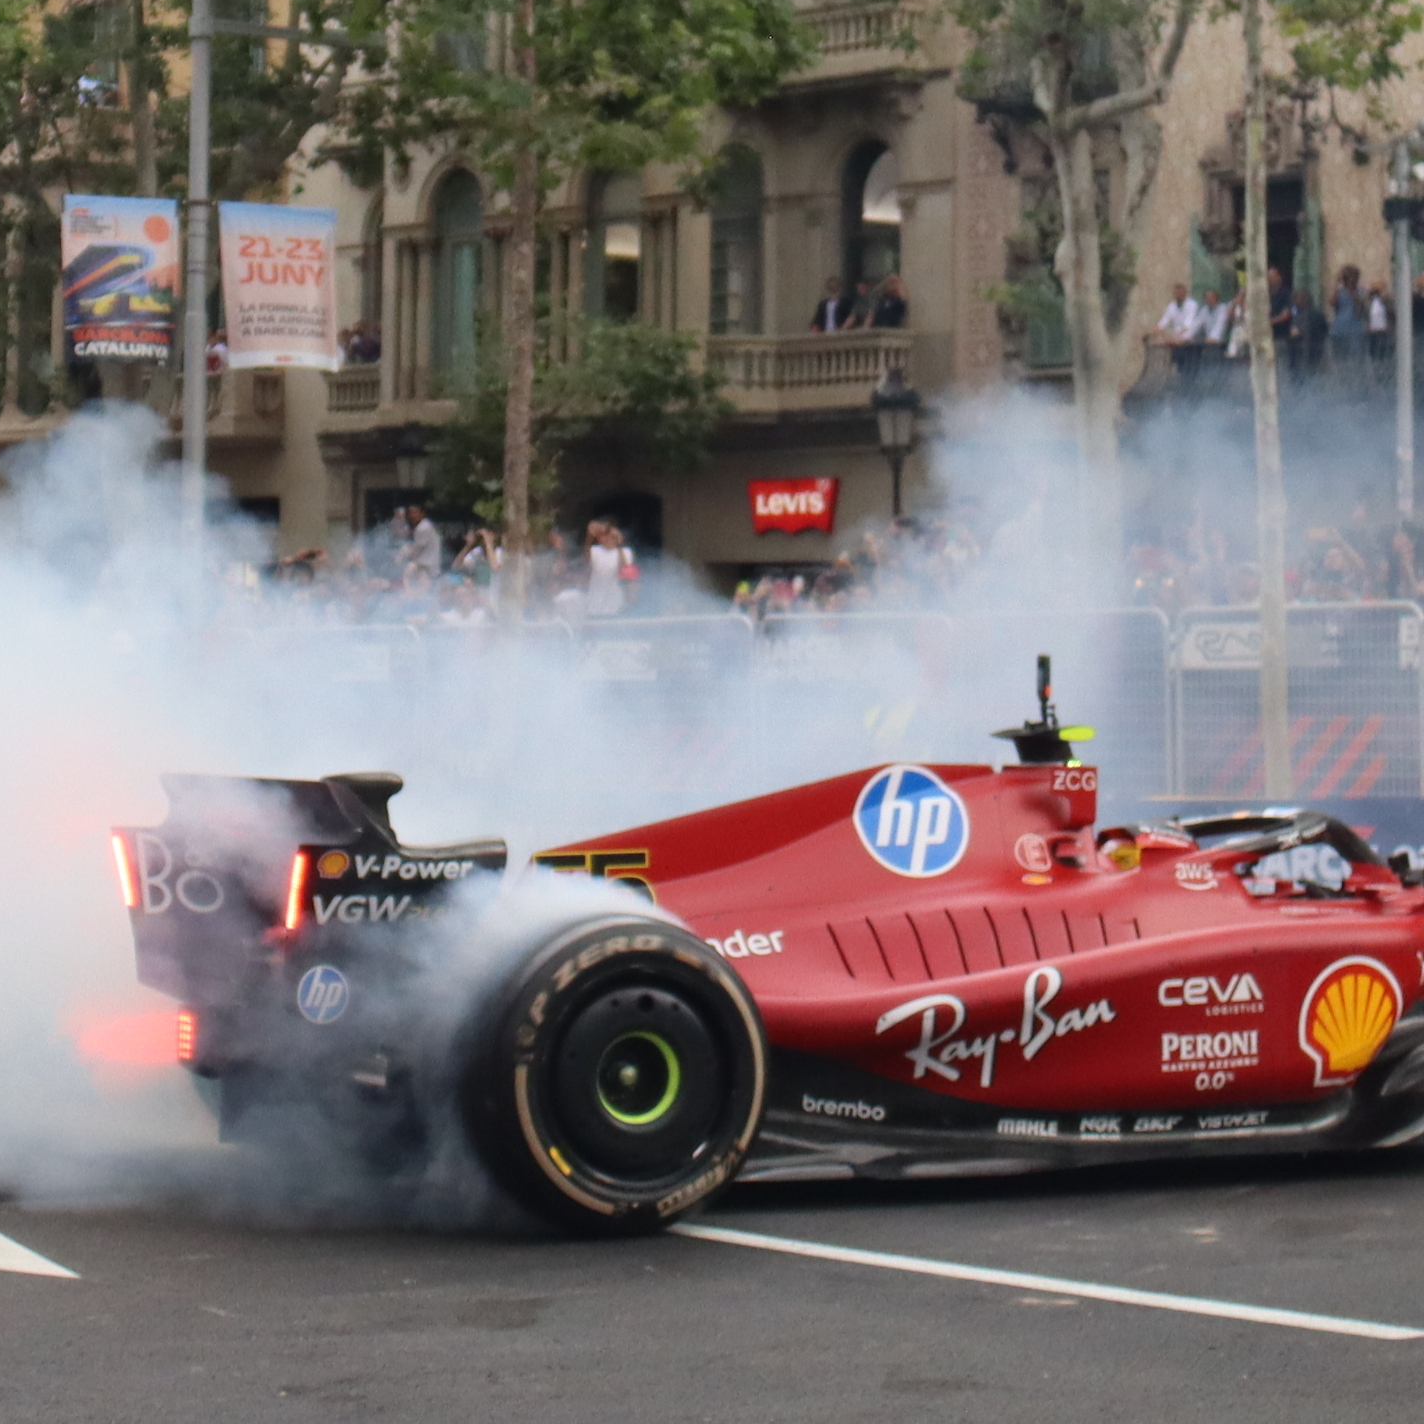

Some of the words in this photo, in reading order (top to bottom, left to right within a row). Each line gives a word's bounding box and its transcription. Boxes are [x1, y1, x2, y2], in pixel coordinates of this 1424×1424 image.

[238, 259, 326, 286] JUNY
[876, 768, 953, 876] hp
[353, 854, 474, 880] V-Power
[1175, 862, 1213, 881] aws
[313, 894, 411, 926] VGW
[875, 965, 1117, 1089] Ray-Ban
[1161, 1029, 1259, 1062] PERONI
[802, 1094, 886, 1121] brembo
[997, 1117, 1059, 1137] MAHLE
